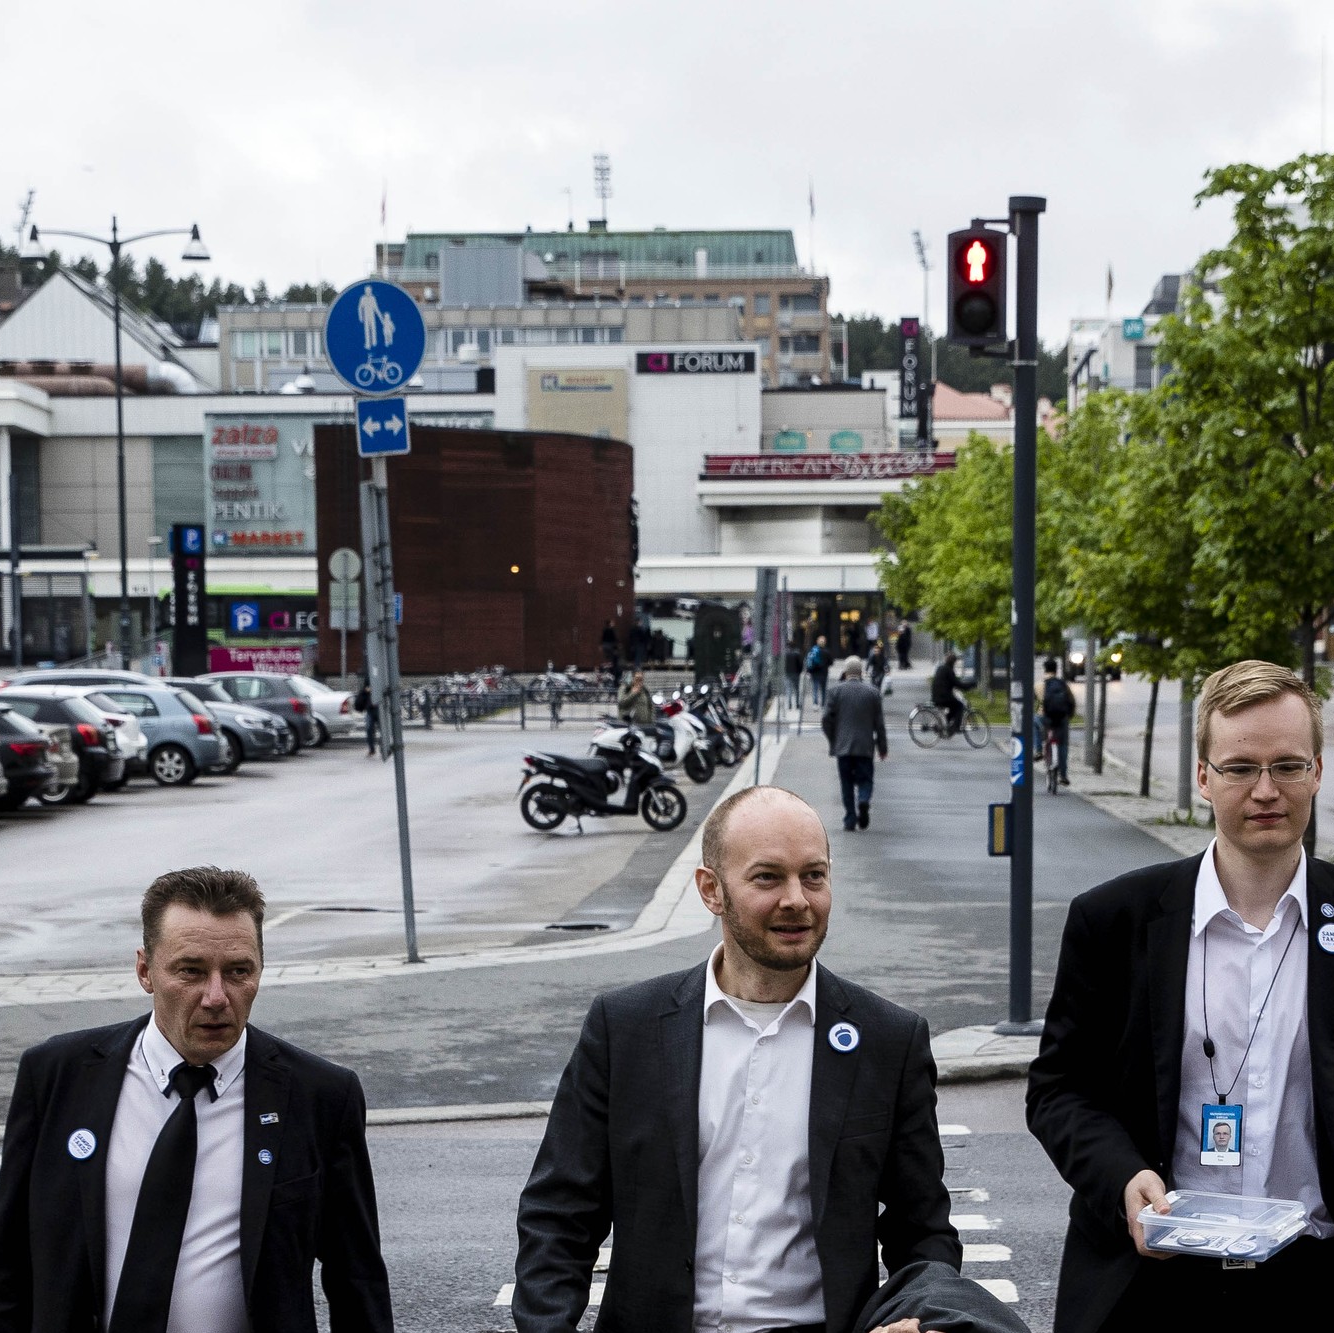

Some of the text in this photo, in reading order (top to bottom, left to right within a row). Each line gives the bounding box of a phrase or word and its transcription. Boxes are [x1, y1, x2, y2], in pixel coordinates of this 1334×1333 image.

[673, 353, 746, 372] FORUM
[901, 338, 918, 416] FORUM
[729, 457, 831, 476] AMERICAN
[213, 501, 288, 521] PENTIK
[231, 530, 305, 545] MARKET
[229, 649, 302, 663] Tervetuloa
